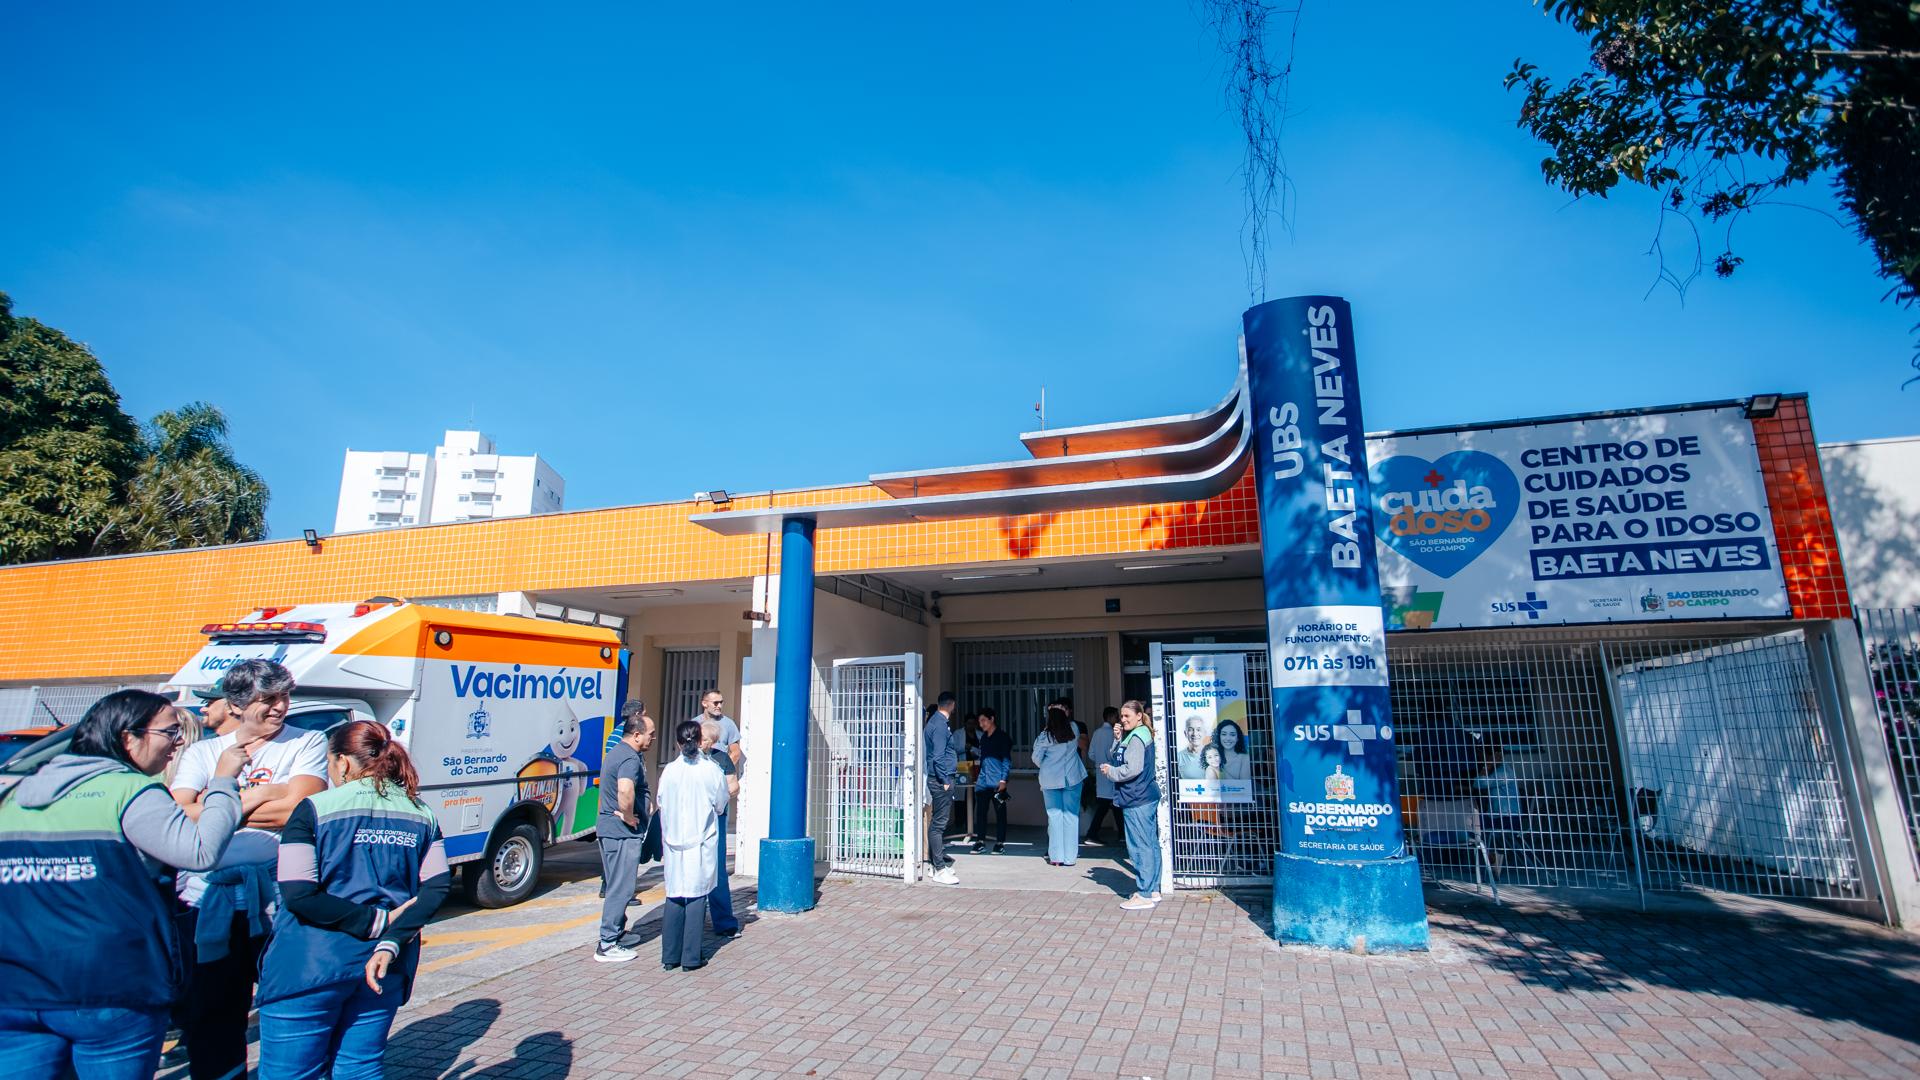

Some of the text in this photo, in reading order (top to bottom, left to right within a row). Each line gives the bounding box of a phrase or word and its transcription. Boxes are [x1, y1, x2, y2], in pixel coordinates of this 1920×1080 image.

[1270, 402, 1303, 479] UBS
[1308, 305, 1361, 568] BAETA NEVES
[1520, 436, 1701, 469] CENTRO DE
[1524, 463, 1690, 493] CUIDADOS
[1380, 480, 1496, 515] cuida
[1527, 488, 1687, 519] DE SAÚDE
[1390, 505, 1491, 536] doso
[1531, 512, 1761, 545] PARA O IDOSO
[1409, 536, 1475, 547] SÃO BERNARDO
[1434, 545, 1466, 553] CAMPO
[1536, 545, 1761, 577] BAETA NEVES
[1691, 588, 1760, 599] BERNARDO
[1491, 602, 1516, 613] SUS
[1667, 598, 1730, 608] DO CAMPO
[1297, 621, 1358, 632] HORÁRIO DE
[1285, 634, 1371, 644] FUNCIONAMENTO:
[1284, 654, 1376, 671] 07h às 19h
[450, 664, 602, 700] Vacimóvel
[1182, 679, 1226, 688] Posto de
[1182, 688, 1238, 700] vacinação
[1183, 698, 1210, 710] aqui!
[1293, 724, 1331, 741] SUS
[443, 753, 507, 768] São Bernardo
[450, 764, 498, 776] do Campo
[441, 788, 469, 798] Cidade
[444, 795, 482, 808] pra frente
[1289, 801, 1394, 815] SÃO BERNARDO
[1305, 814, 1378, 828] DO CAMPO
[353, 833, 418, 848] ZOONOSES
[384, 830, 411, 838] CONTROLE
[1299, 841, 1346, 850] SECRETARIA
[1361, 842, 1385, 851] SAÚDE
[0, 864, 96, 883] OONOSES
